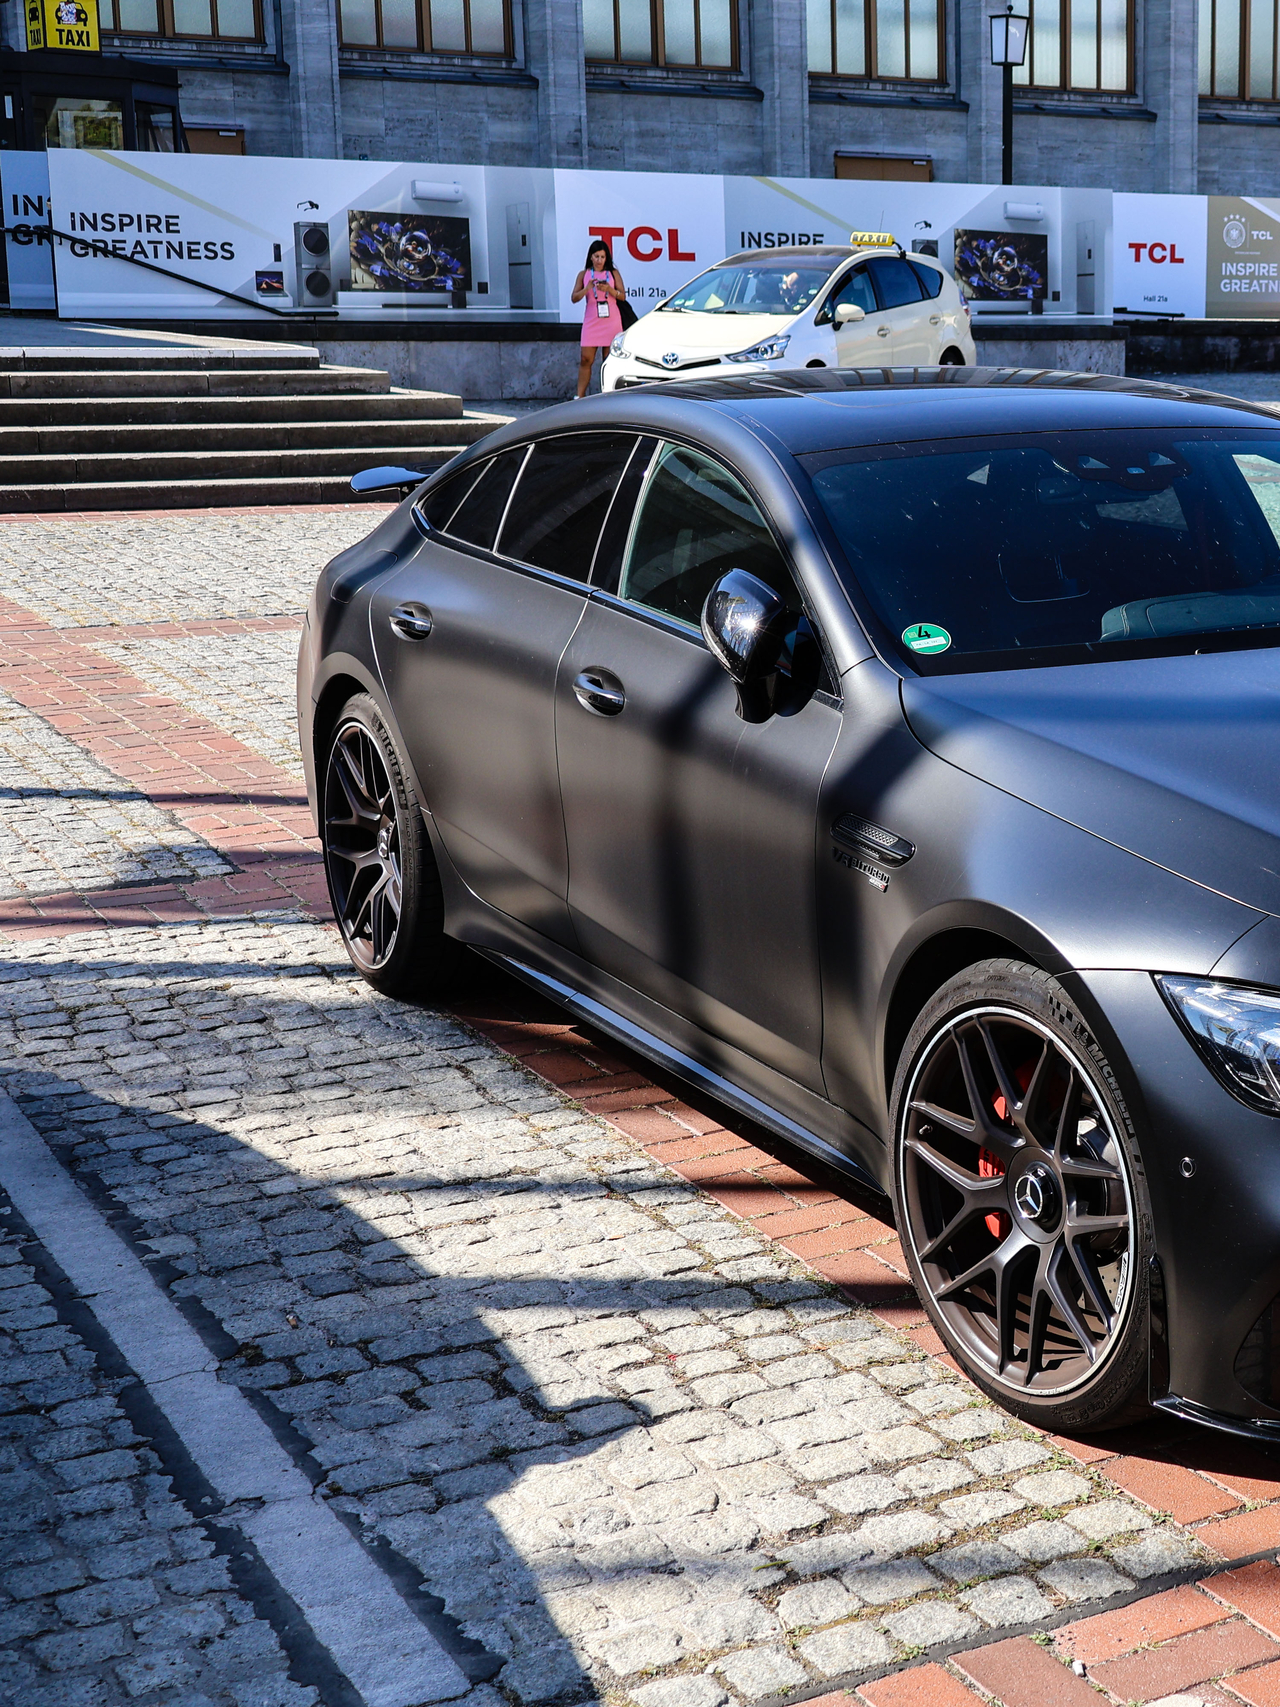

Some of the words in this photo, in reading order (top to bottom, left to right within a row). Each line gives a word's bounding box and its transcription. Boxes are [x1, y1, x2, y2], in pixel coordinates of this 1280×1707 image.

[55, 28, 90, 47] TAXI
[70, 212, 180, 234] INSPIRE
[589, 226, 696, 262] TCL
[740, 231, 825, 249] INSPIRE
[853, 233, 887, 243] TAXI
[1251, 231, 1273, 240] TCL
[70, 238, 235, 261] GREATNESS
[1128, 242, 1185, 264] TCL
[1221, 262, 1278, 276] INSPIRE
[648, 287, 667, 298] 21a
[918, 625, 931, 639] 4
[851, 857, 889, 883] BITURBO
[1088, 1042, 1135, 1134] MICHELIN
